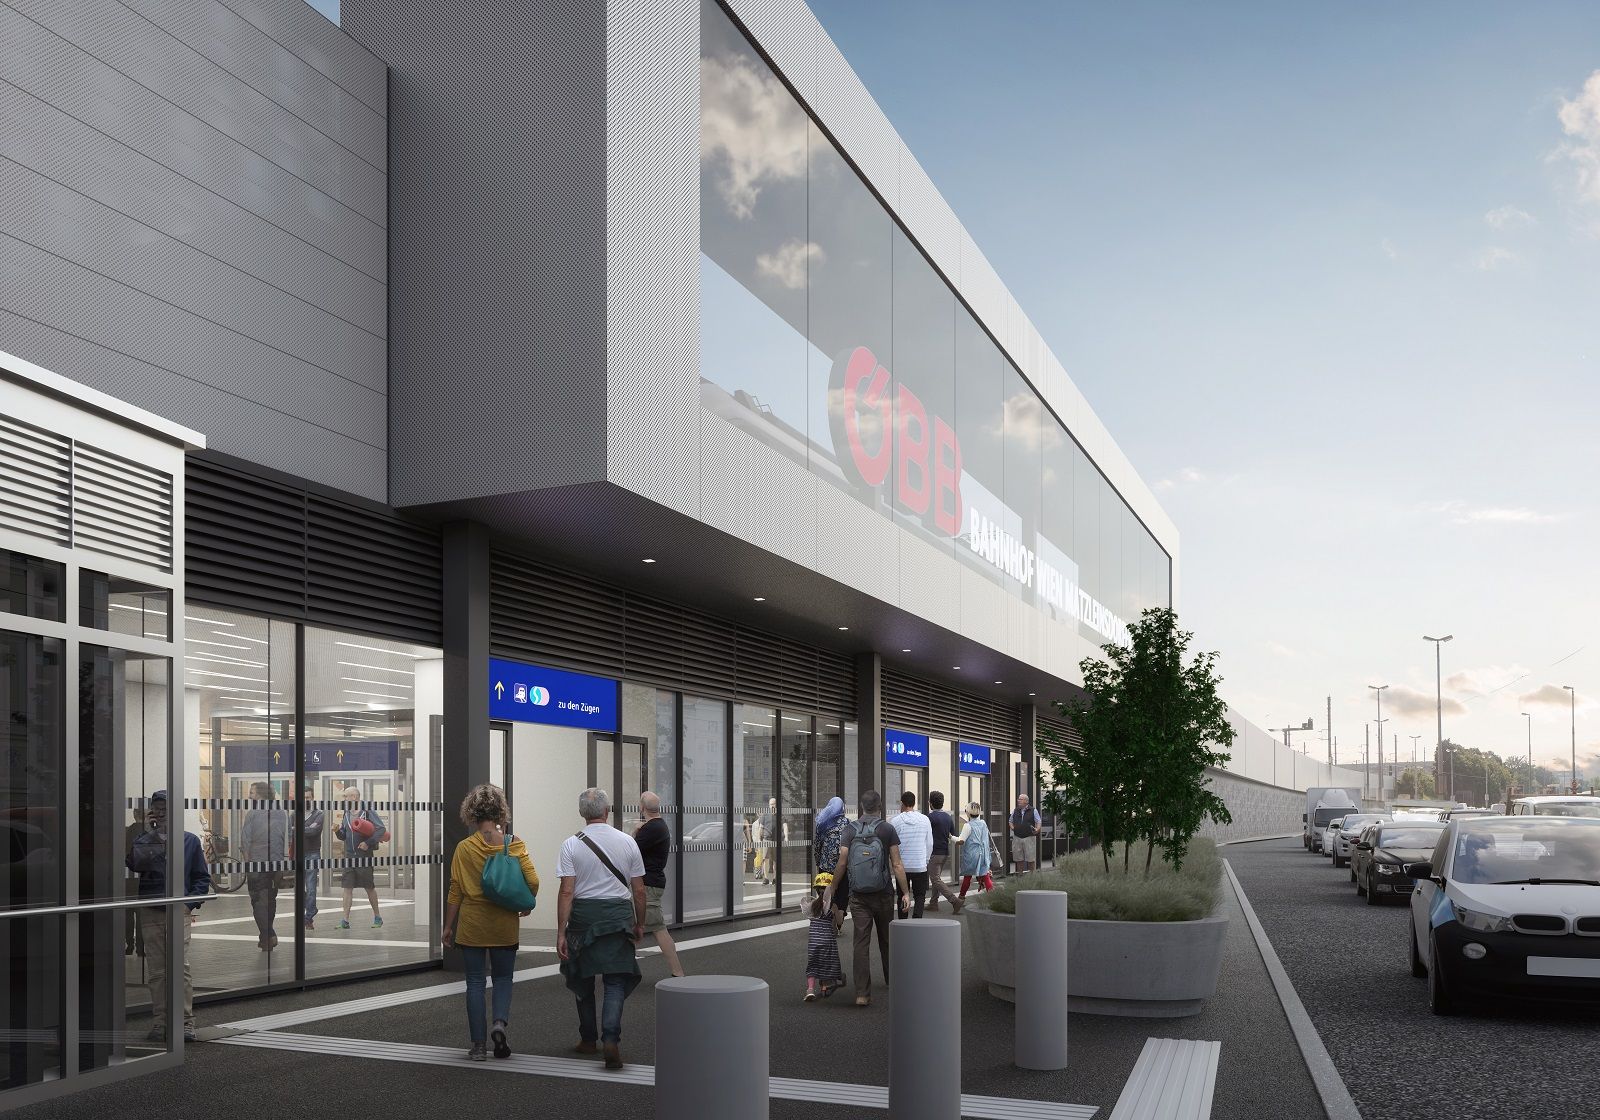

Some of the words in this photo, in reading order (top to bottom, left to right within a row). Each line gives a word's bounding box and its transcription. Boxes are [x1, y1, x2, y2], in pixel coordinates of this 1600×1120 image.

[970, 506, 1034, 588] BAHNHOF
[1036, 556, 1063, 609] WIEN
[558, 701, 566, 709] zu
[567, 701, 580, 710] den
[580, 702, 600, 714] Zügen
